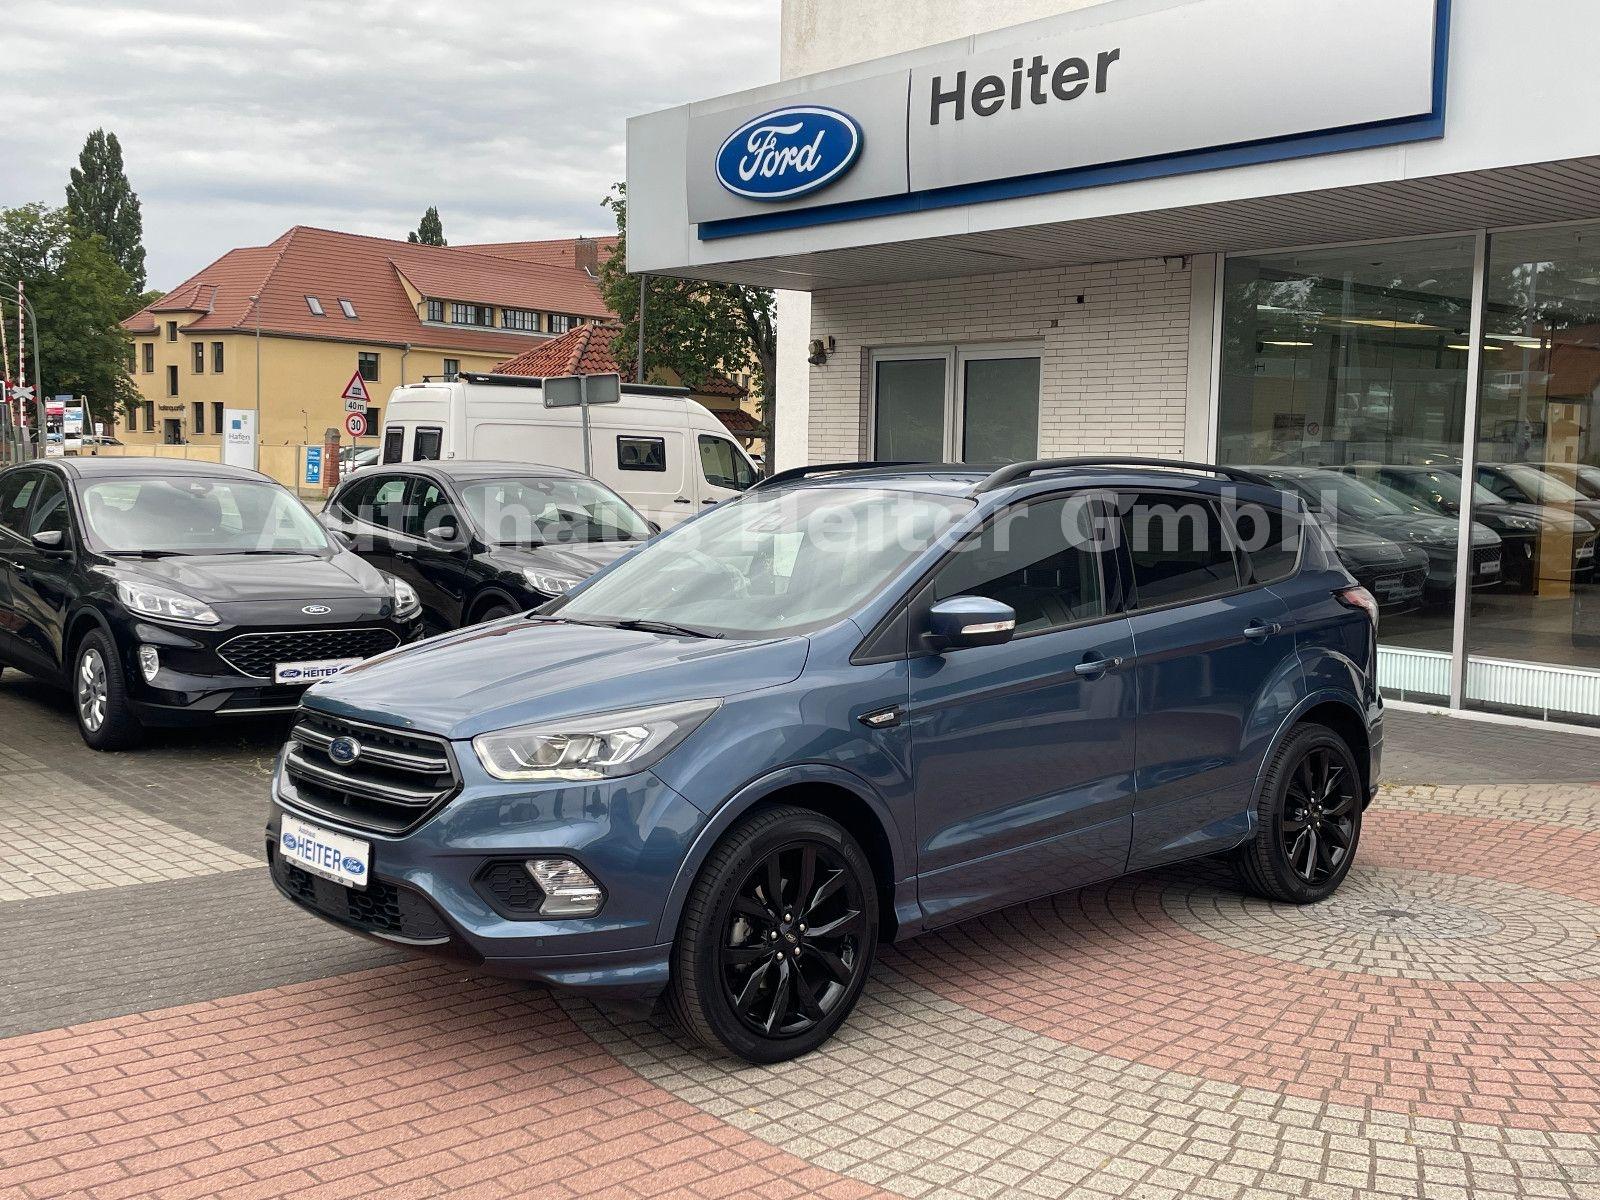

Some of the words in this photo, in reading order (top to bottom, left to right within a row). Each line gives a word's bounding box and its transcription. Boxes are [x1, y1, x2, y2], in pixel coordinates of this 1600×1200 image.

[929, 47, 1121, 126] Heiter
[738, 121, 826, 182] Ford
[349, 402, 358, 411] 40
[228, 432, 251, 441] Hafen
[351, 420, 361, 431] 30
[297, 836, 342, 871] HEITER
